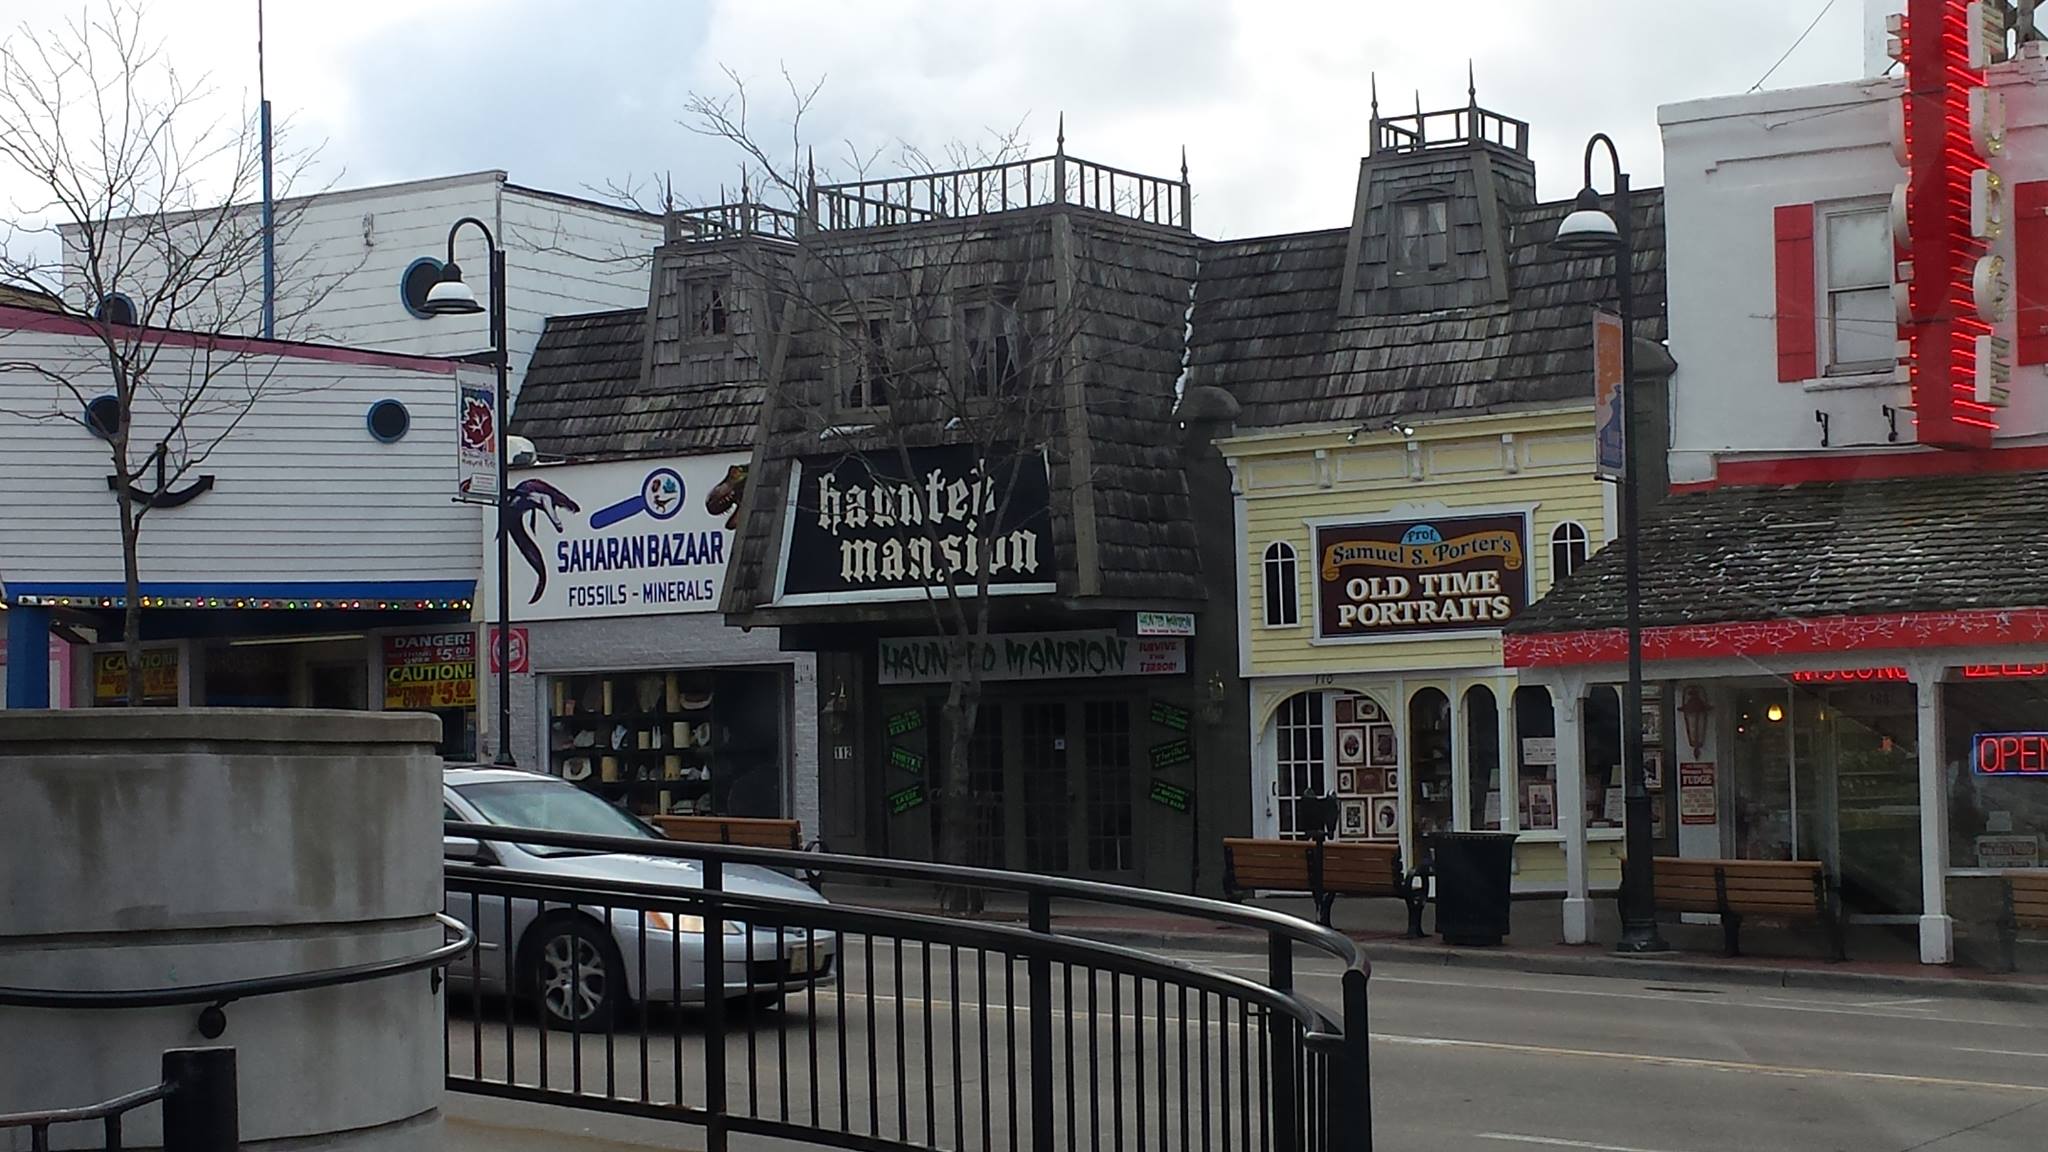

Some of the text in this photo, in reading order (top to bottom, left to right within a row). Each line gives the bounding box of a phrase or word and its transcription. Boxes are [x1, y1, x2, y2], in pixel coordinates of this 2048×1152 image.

[817, 457, 996, 535] haunted
[557, 530, 724, 573] SAHARAN BAZAAR
[840, 518, 1039, 583] mansion
[1333, 535, 1512, 565] Samuel S. Porter's
[569, 583, 628, 607] FOSSILS
[642, 579, 714, 604] MINERALS
[1346, 570, 1500, 601] OLD TIME
[1338, 596, 1511, 627] PORTRAITS
[394, 633, 471, 648] DANGER!
[1139, 640, 1177, 652] SURVIVE
[105, 653, 177, 670] CAION!
[881, 635, 1127, 679] HAUNED MANSION
[388, 663, 473, 682] CAUTION!
[1682, 775, 1713, 785] FUDGE
